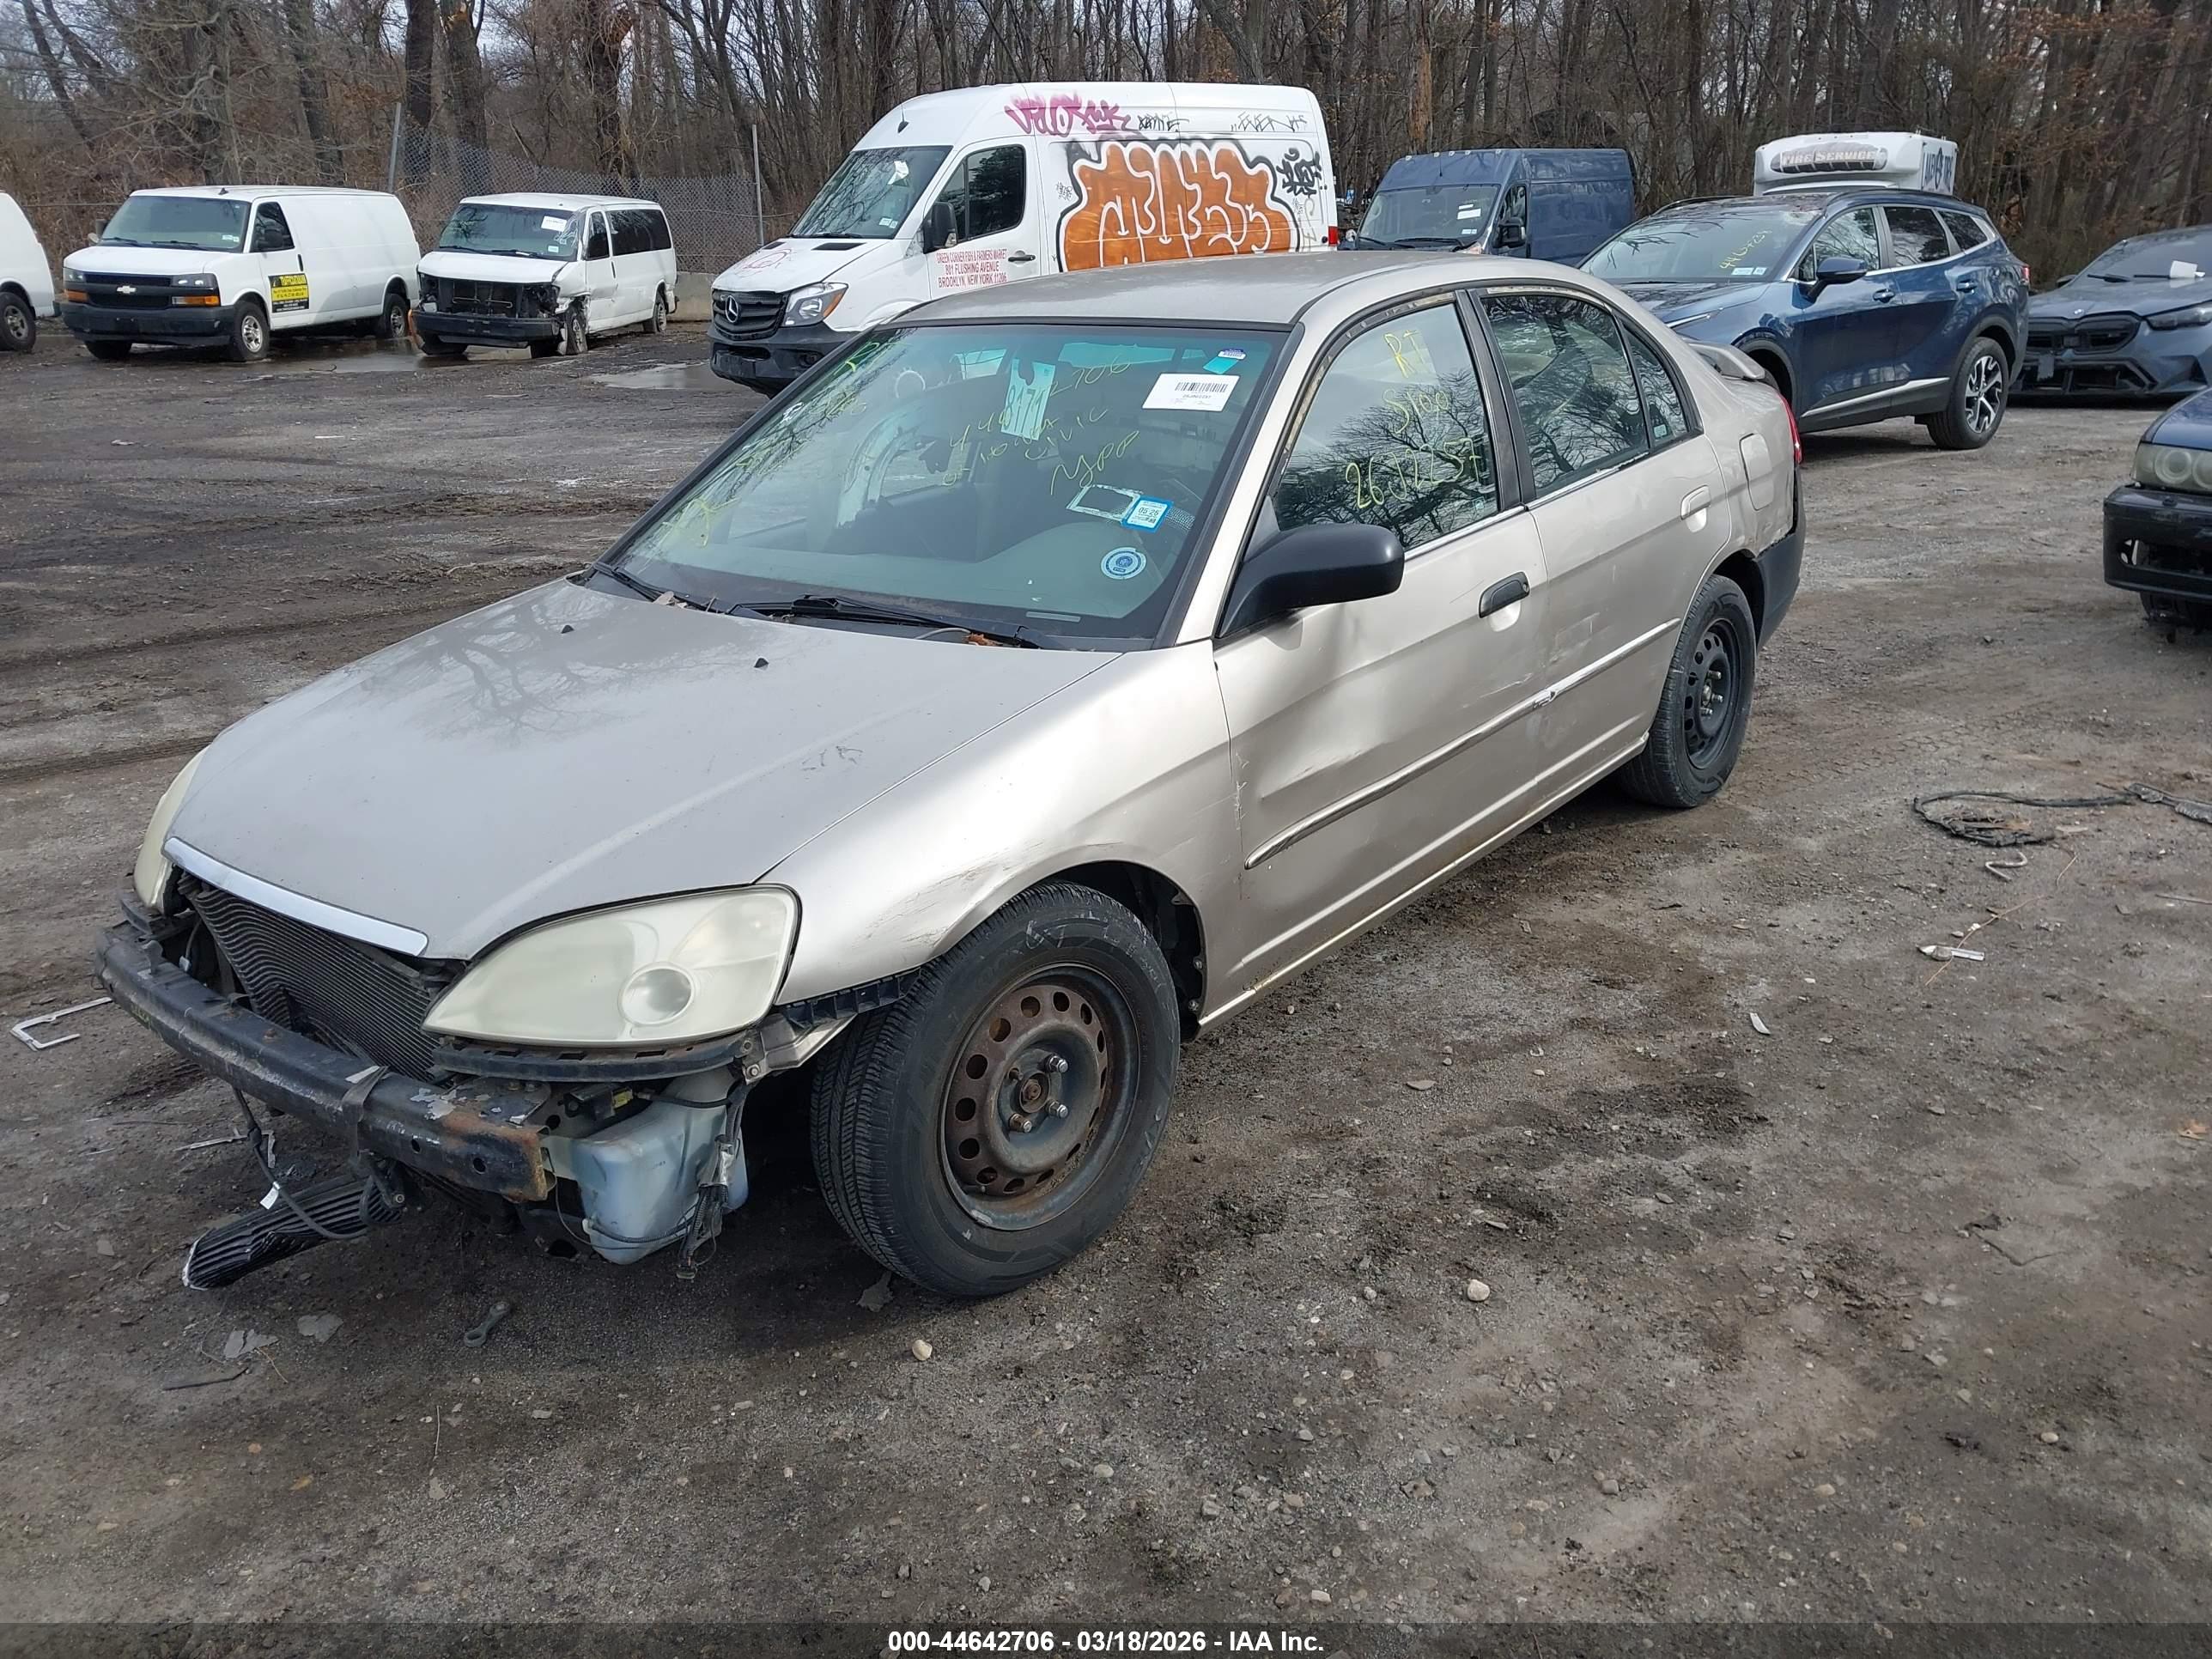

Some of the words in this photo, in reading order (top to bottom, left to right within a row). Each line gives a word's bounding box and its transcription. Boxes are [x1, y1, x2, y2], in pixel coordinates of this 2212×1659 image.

[1814, 149, 1876, 162] SERVICE
[937, 252, 949, 263] GREEN
[951, 252, 964, 262] CORNER
[976, 249, 993, 261] FARMERS
[994, 249, 1006, 259] MARKET
[955, 263, 979, 275] FLUSHING
[980, 261, 1000, 273] AVENUE
[939, 276, 965, 288] BROOKLYN,
[967, 274, 978, 286] NEW
[979, 273, 993, 285] YORK
[994, 272, 1006, 283] 11206
